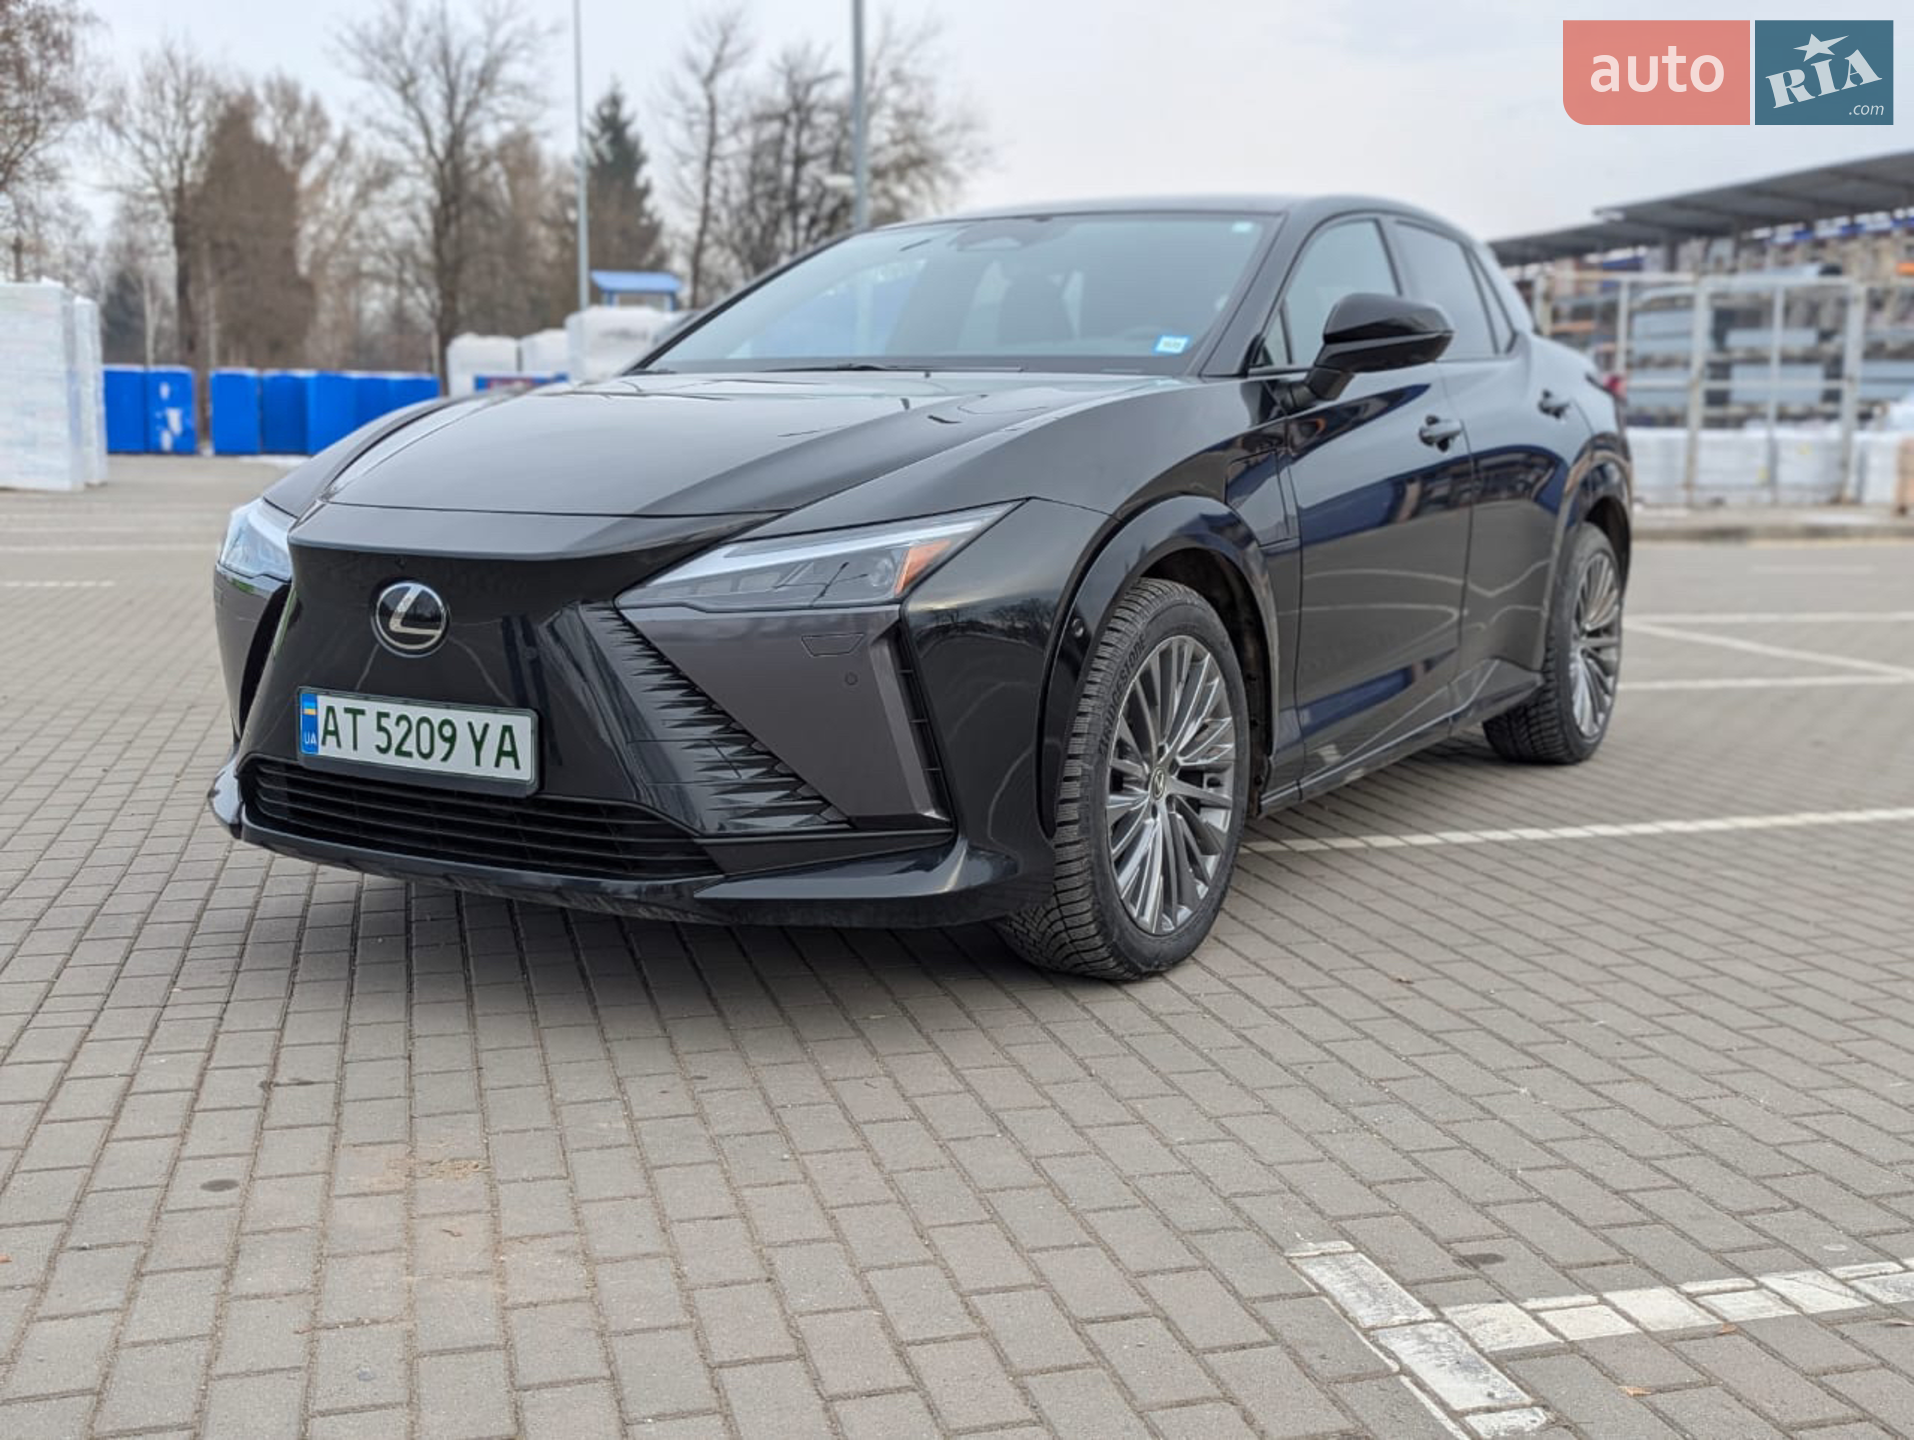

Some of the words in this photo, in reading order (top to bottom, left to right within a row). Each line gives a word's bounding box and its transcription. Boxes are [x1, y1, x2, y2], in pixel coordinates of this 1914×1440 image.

[1098, 632, 1146, 757] BRIDGESTONE
[303, 731, 318, 745] UA
[321, 705, 366, 751] AT
[375, 711, 457, 762] 5209
[467, 721, 521, 771] YA
